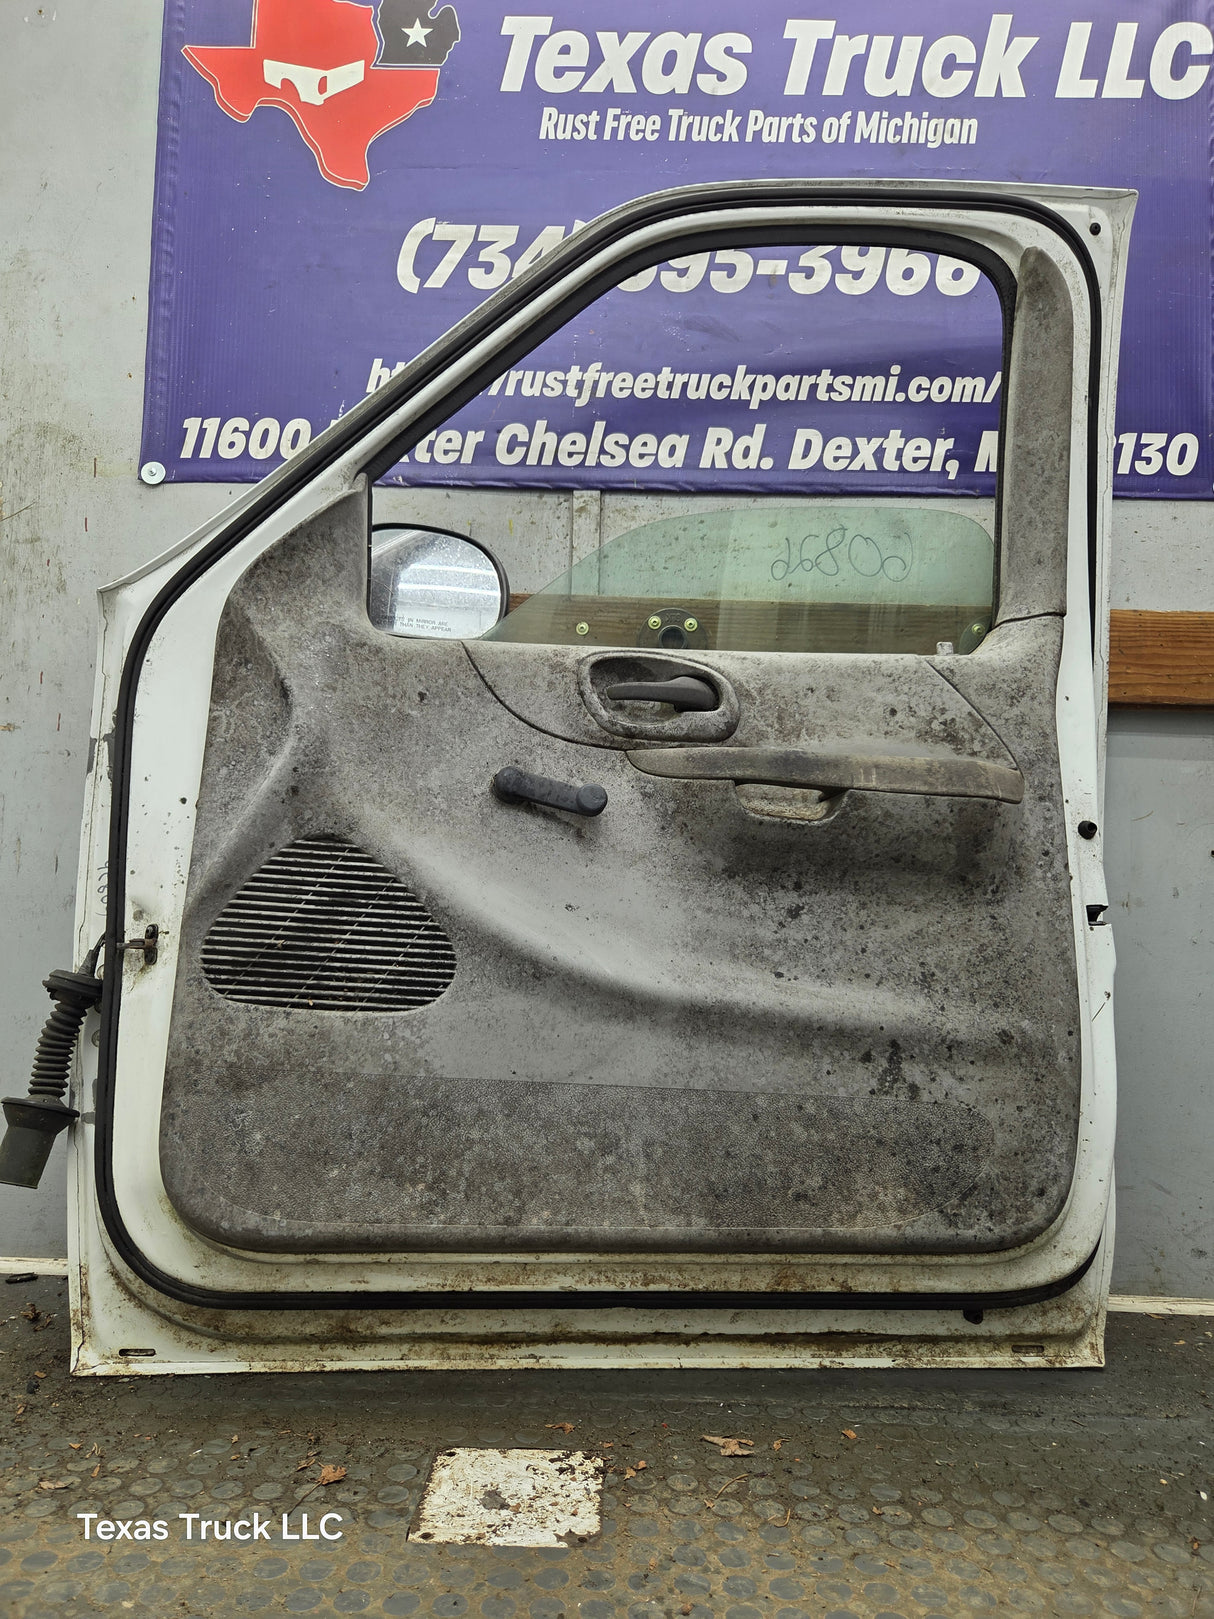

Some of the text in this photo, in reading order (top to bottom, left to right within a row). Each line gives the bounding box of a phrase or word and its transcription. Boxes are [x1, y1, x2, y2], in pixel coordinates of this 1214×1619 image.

[500, 14, 1214, 100] Texas Truck LLC
[539, 107, 978, 148] Rust Free Truck Parts of Michigan
[180, 417, 311, 460] 11600
[495, 420, 690, 468] Chelsea
[699, 424, 774, 469] Rd.
[788, 429, 960, 480] Dexter,
